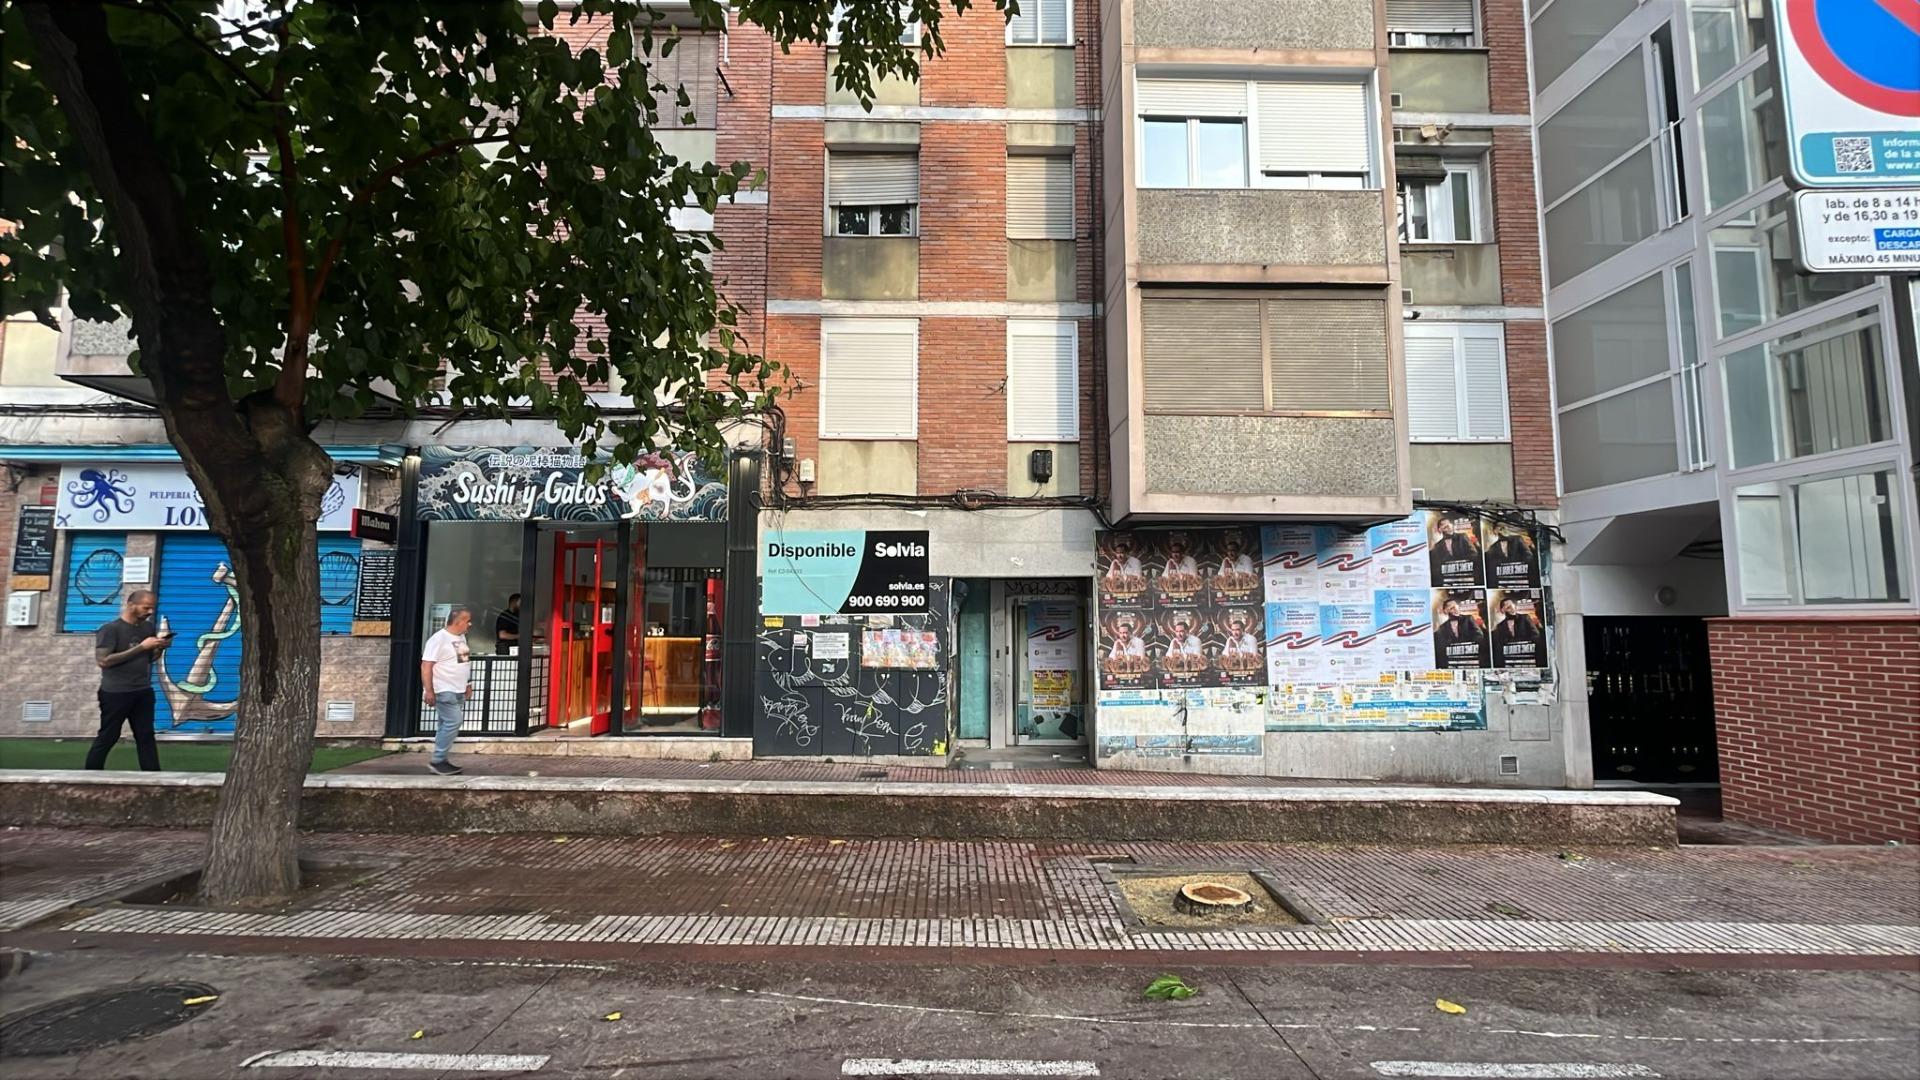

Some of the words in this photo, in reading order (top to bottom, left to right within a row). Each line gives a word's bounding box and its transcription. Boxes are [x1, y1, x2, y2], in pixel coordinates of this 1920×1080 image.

[1884, 149, 1898, 158] de
[1901, 149, 1911, 158] la
[1826, 198, 1849, 208] lab.
[1853, 198, 1869, 208] de
[1873, 198, 1880, 207] 8
[1896, 196, 1911, 207] 14
[1823, 214, 1830, 224] y
[1834, 211, 1850, 221] de
[1854, 210, 1888, 222] 16,30
[1892, 212, 1899, 220] a
[1903, 209, 1918, 220] 19
[1828, 235, 1870, 243] excepto:
[1877, 254, 1890, 263] 45
[149, 491, 191, 499] PULPERIA
[453, 471, 518, 504] Sushi
[520, 484, 537, 519] y
[544, 471, 609, 504] Gatos
[361, 515, 390, 530] Mahou
[768, 543, 856, 560] Disponible
[875, 542, 925, 557] Solvia
[888, 581, 925, 591] solvia.es
[849, 595, 873, 607] 900
[875, 595, 899, 607] 690
[901, 595, 925, 607] 900
